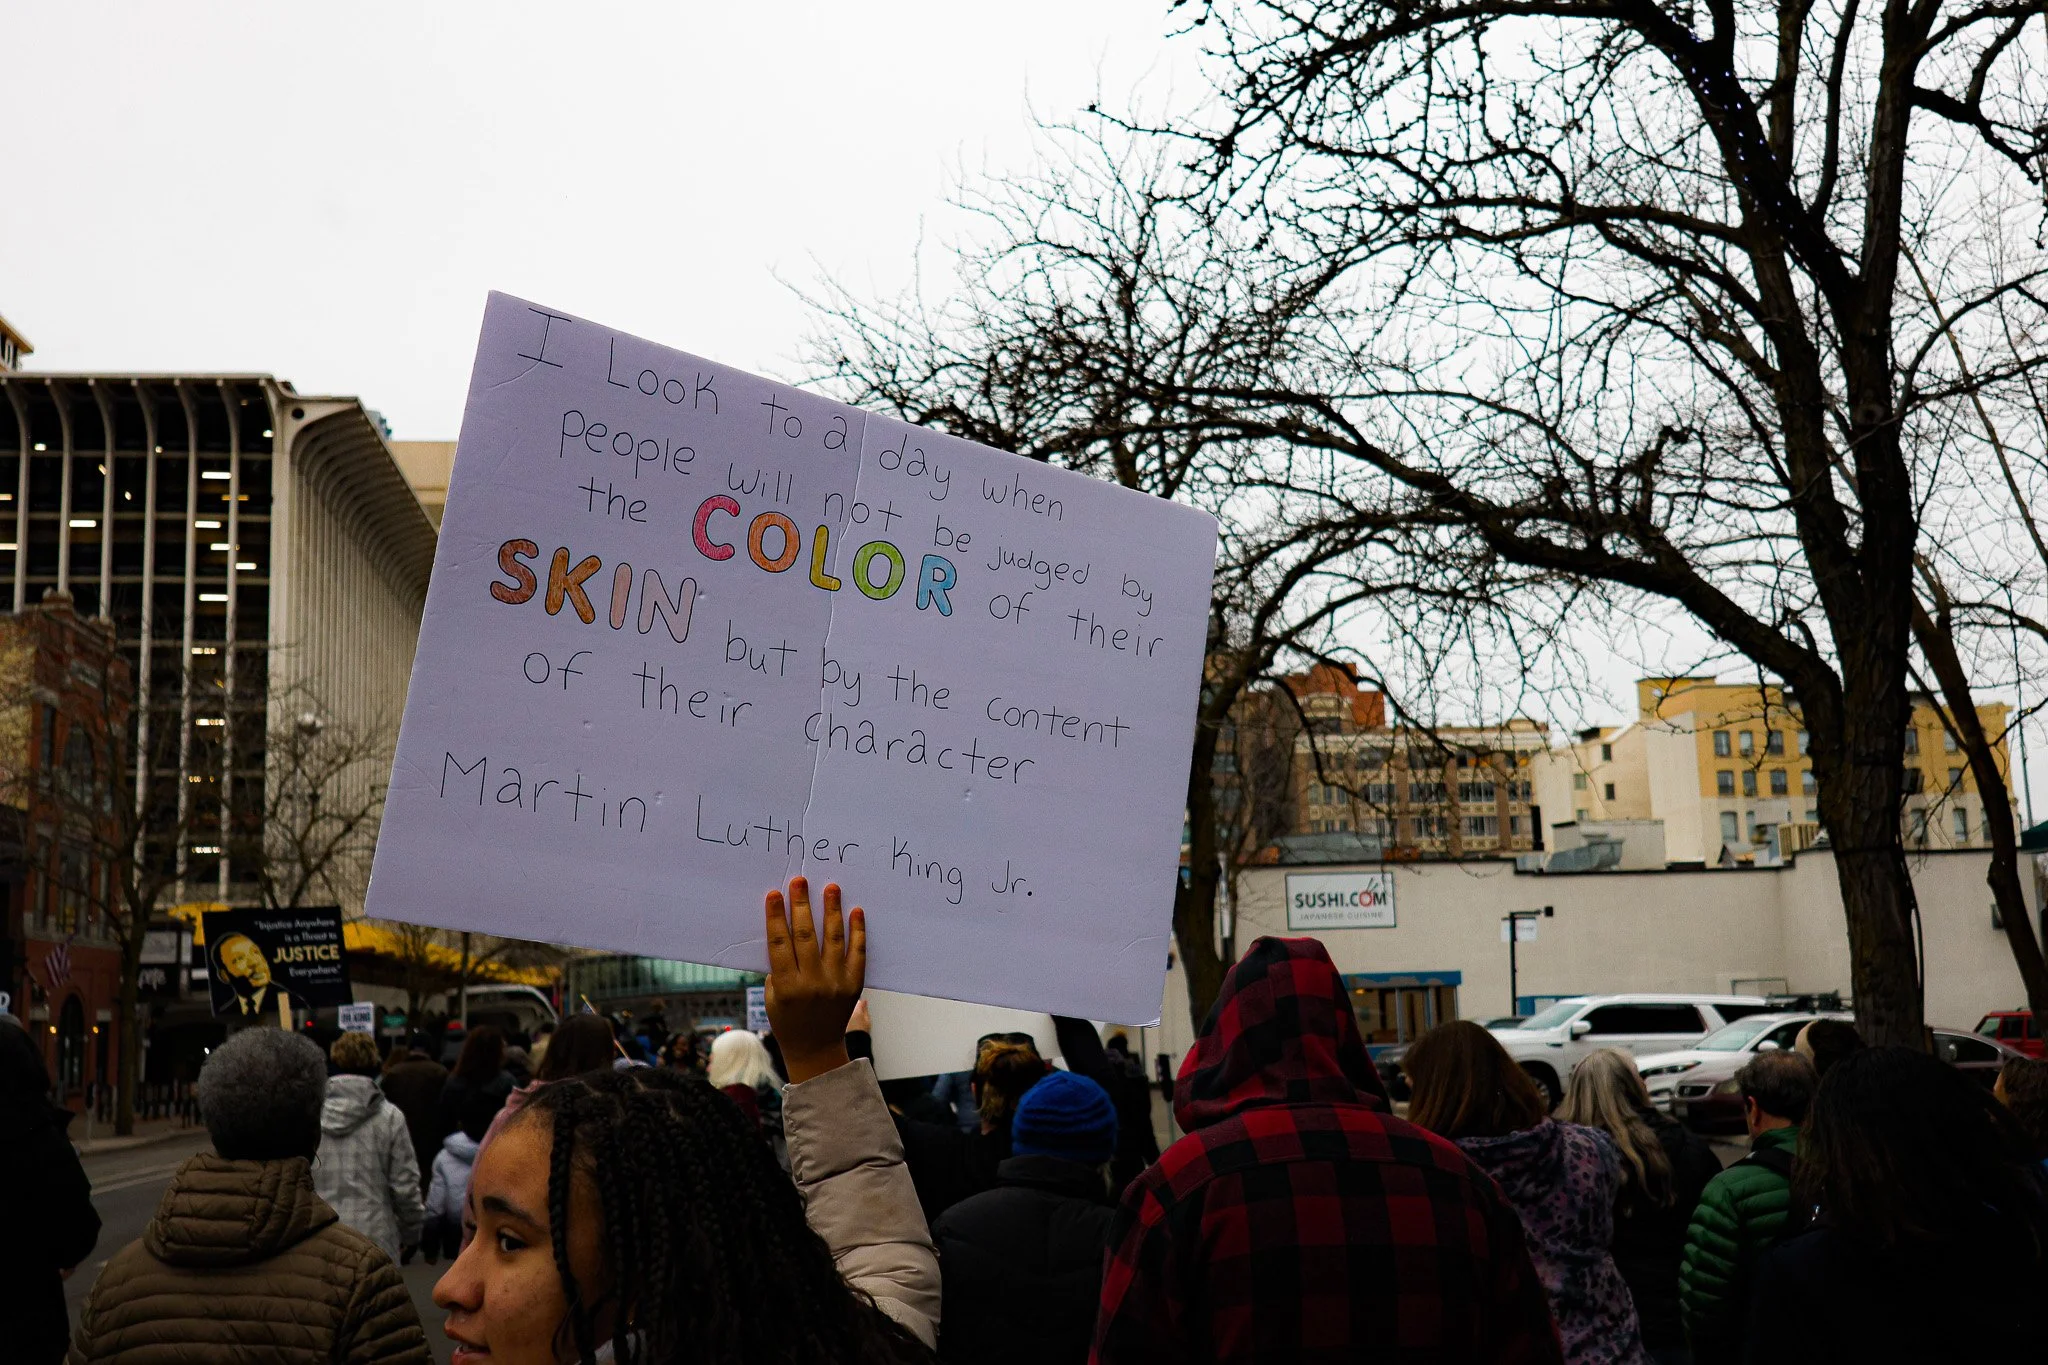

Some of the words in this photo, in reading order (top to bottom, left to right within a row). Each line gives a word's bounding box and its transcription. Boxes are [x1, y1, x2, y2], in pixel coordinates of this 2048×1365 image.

[517, 307, 572, 368] I
[607, 337, 718, 415] Look
[760, 394, 803, 438] to
[824, 416, 848, 452] a
[879, 434, 951, 501] day
[983, 473, 1063, 521] when
[560, 410, 695, 479] people
[728, 463, 793, 505] will
[824, 492, 902, 532] not
[934, 515, 972, 552] be
[987, 534, 1090, 590] judged
[1121, 573, 1153, 617] by
[578, 477, 647, 523] the
[692, 494, 957, 617] COLOR
[988, 592, 1033, 624] of
[1067, 608, 1164, 658] their
[490, 538, 697, 643] SKIN
[726, 620, 797, 676] but
[822, 647, 861, 707] by
[887, 665, 950, 709] the
[987, 697, 1131, 748] content
[523, 650, 593, 690] of
[632, 662, 753, 727] their
[440, 752, 646, 832] Martin
[697, 795, 860, 863] Luther
[991, 860, 1033, 896] Jr.
[284, 933, 291, 942] is
[302, 931, 327, 942] Threat
[328, 931, 338, 940] to
[295, 917, 336, 929] Anywhere
[1295, 891, 1387, 908] SUSHI.COM
[1300, 912, 1344, 921] JAPANESE
[1347, 911, 1384, 920] CUISINE
[273, 944, 341, 963] JUSTICE
